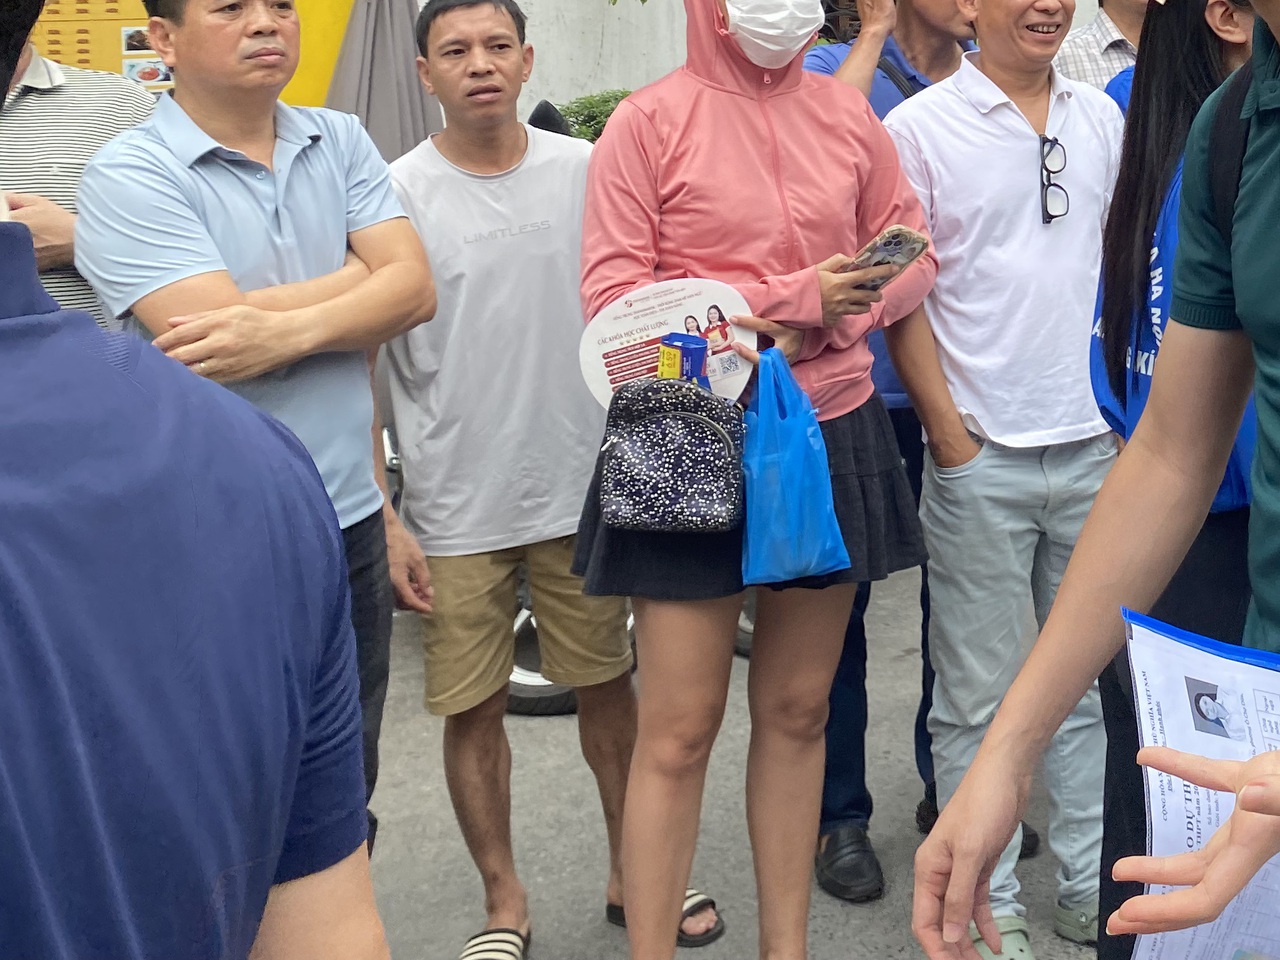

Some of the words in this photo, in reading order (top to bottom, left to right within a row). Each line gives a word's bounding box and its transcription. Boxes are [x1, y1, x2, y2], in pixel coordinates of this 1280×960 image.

[463, 219, 552, 245] LIMITLESS
[1183, 783, 1193, 805] TH
[1160, 798, 1168, 821] CỘNG
[1184, 806, 1196, 831] DỰ
